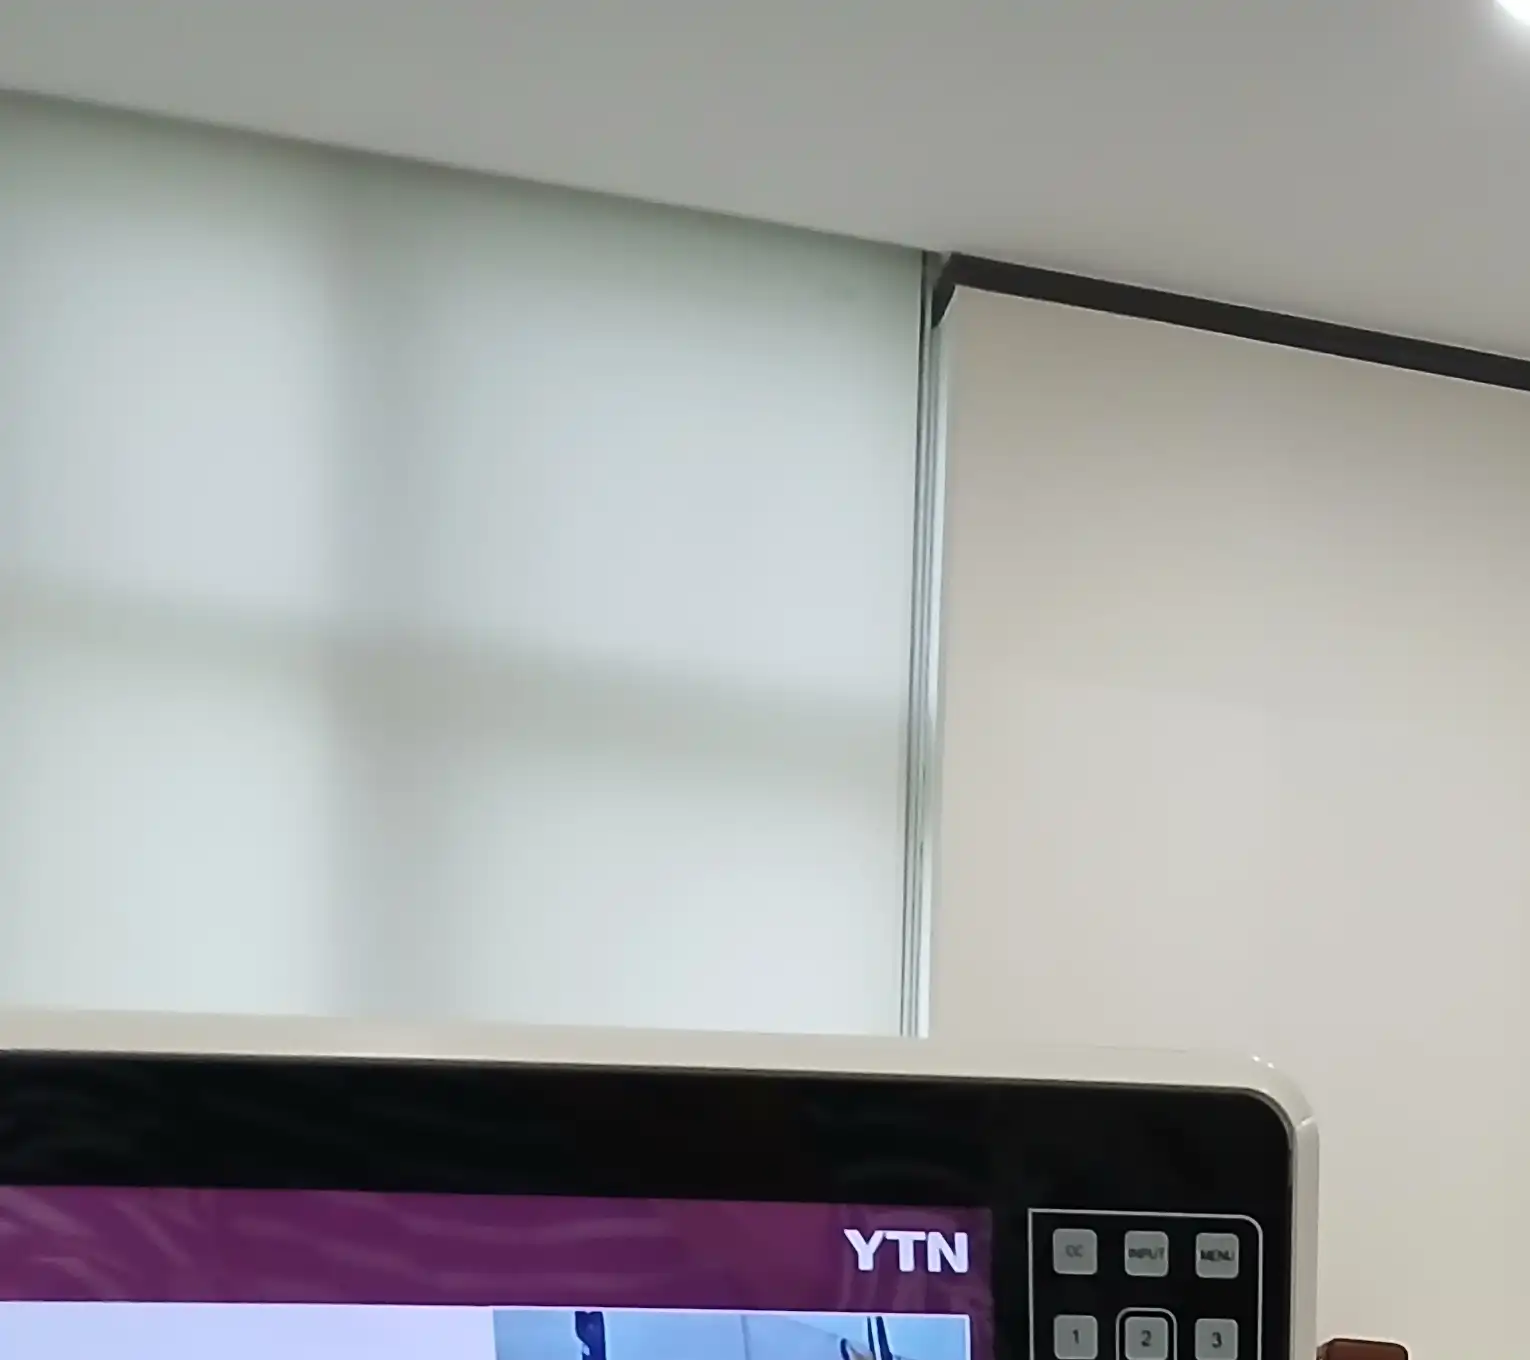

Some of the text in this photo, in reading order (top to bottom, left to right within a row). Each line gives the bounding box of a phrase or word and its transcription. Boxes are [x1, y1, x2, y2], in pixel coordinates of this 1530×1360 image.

[844, 1229, 968, 1273] YTN
[1128, 1247, 1165, 1260] INPUT
[1200, 1249, 1235, 1262] MENU
[1072, 1329, 1080, 1344] 1
[1141, 1330, 1152, 1346] 2
[1212, 1332, 1222, 1348] 3
